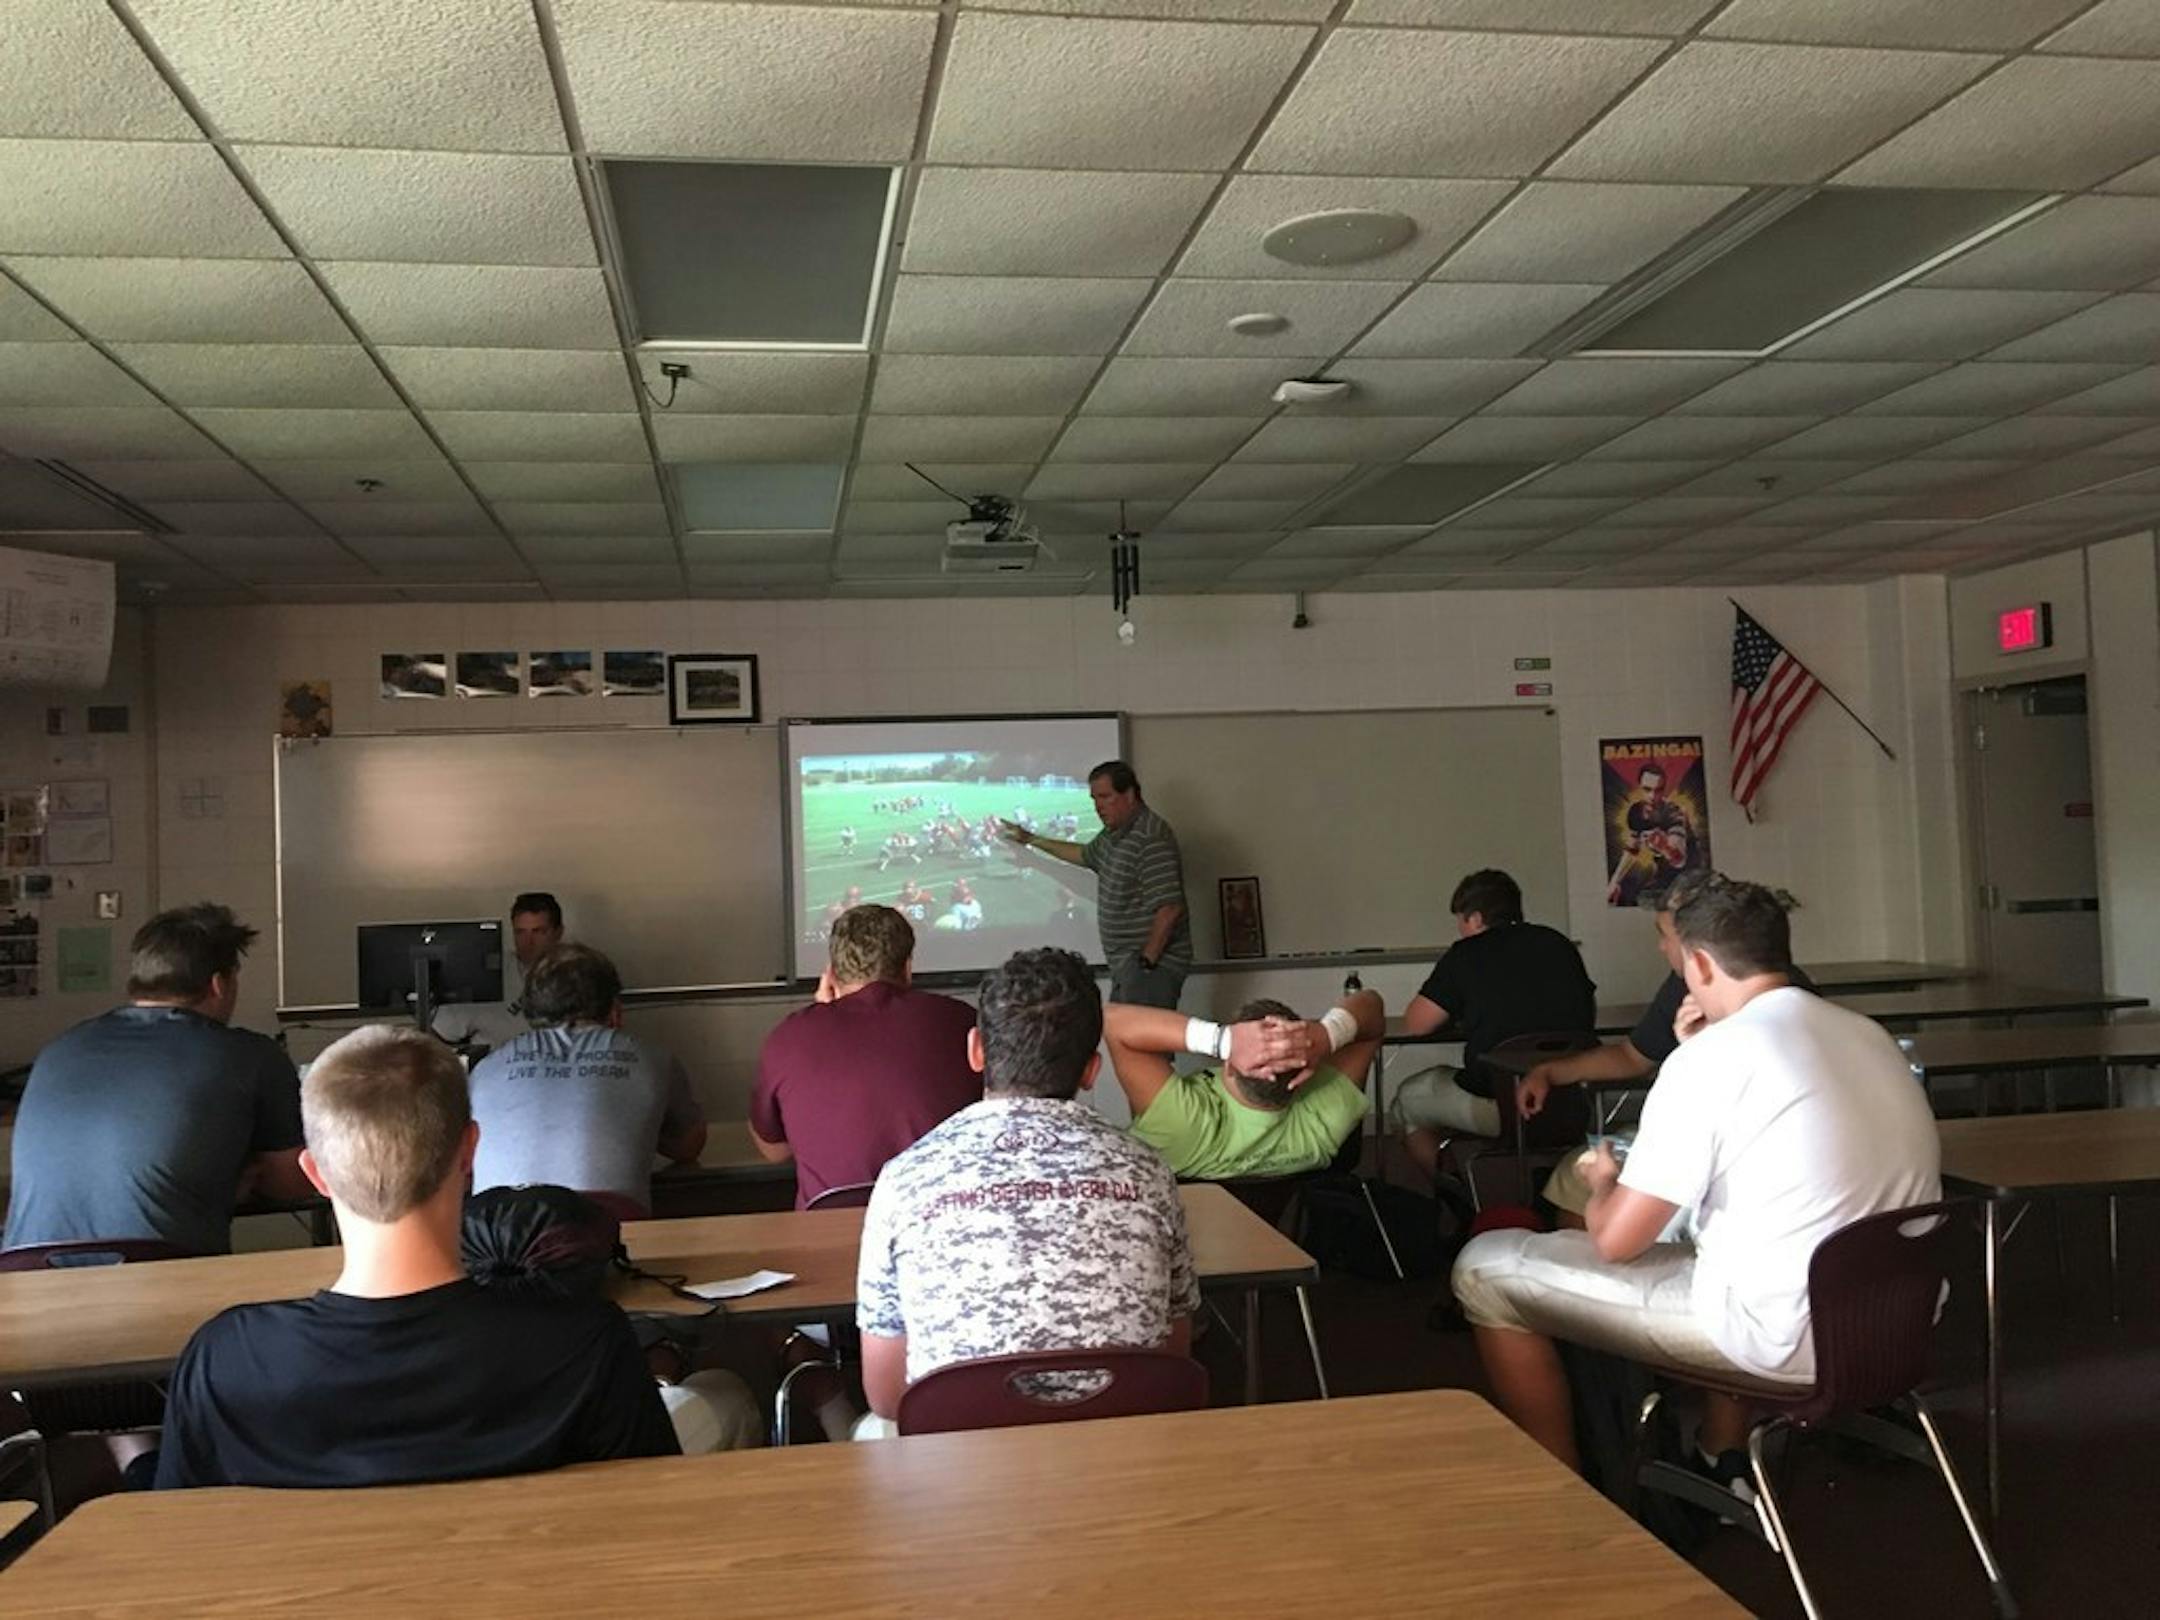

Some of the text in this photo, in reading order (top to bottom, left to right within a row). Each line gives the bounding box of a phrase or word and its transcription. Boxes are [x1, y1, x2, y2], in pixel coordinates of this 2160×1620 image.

[2001, 608, 2036, 649] EXIT
[1603, 741, 1702, 762] BAZINGA!
[508, 1064, 631, 1081] LIVE THE DREAM
[991, 1180, 1052, 1204] BETTER
